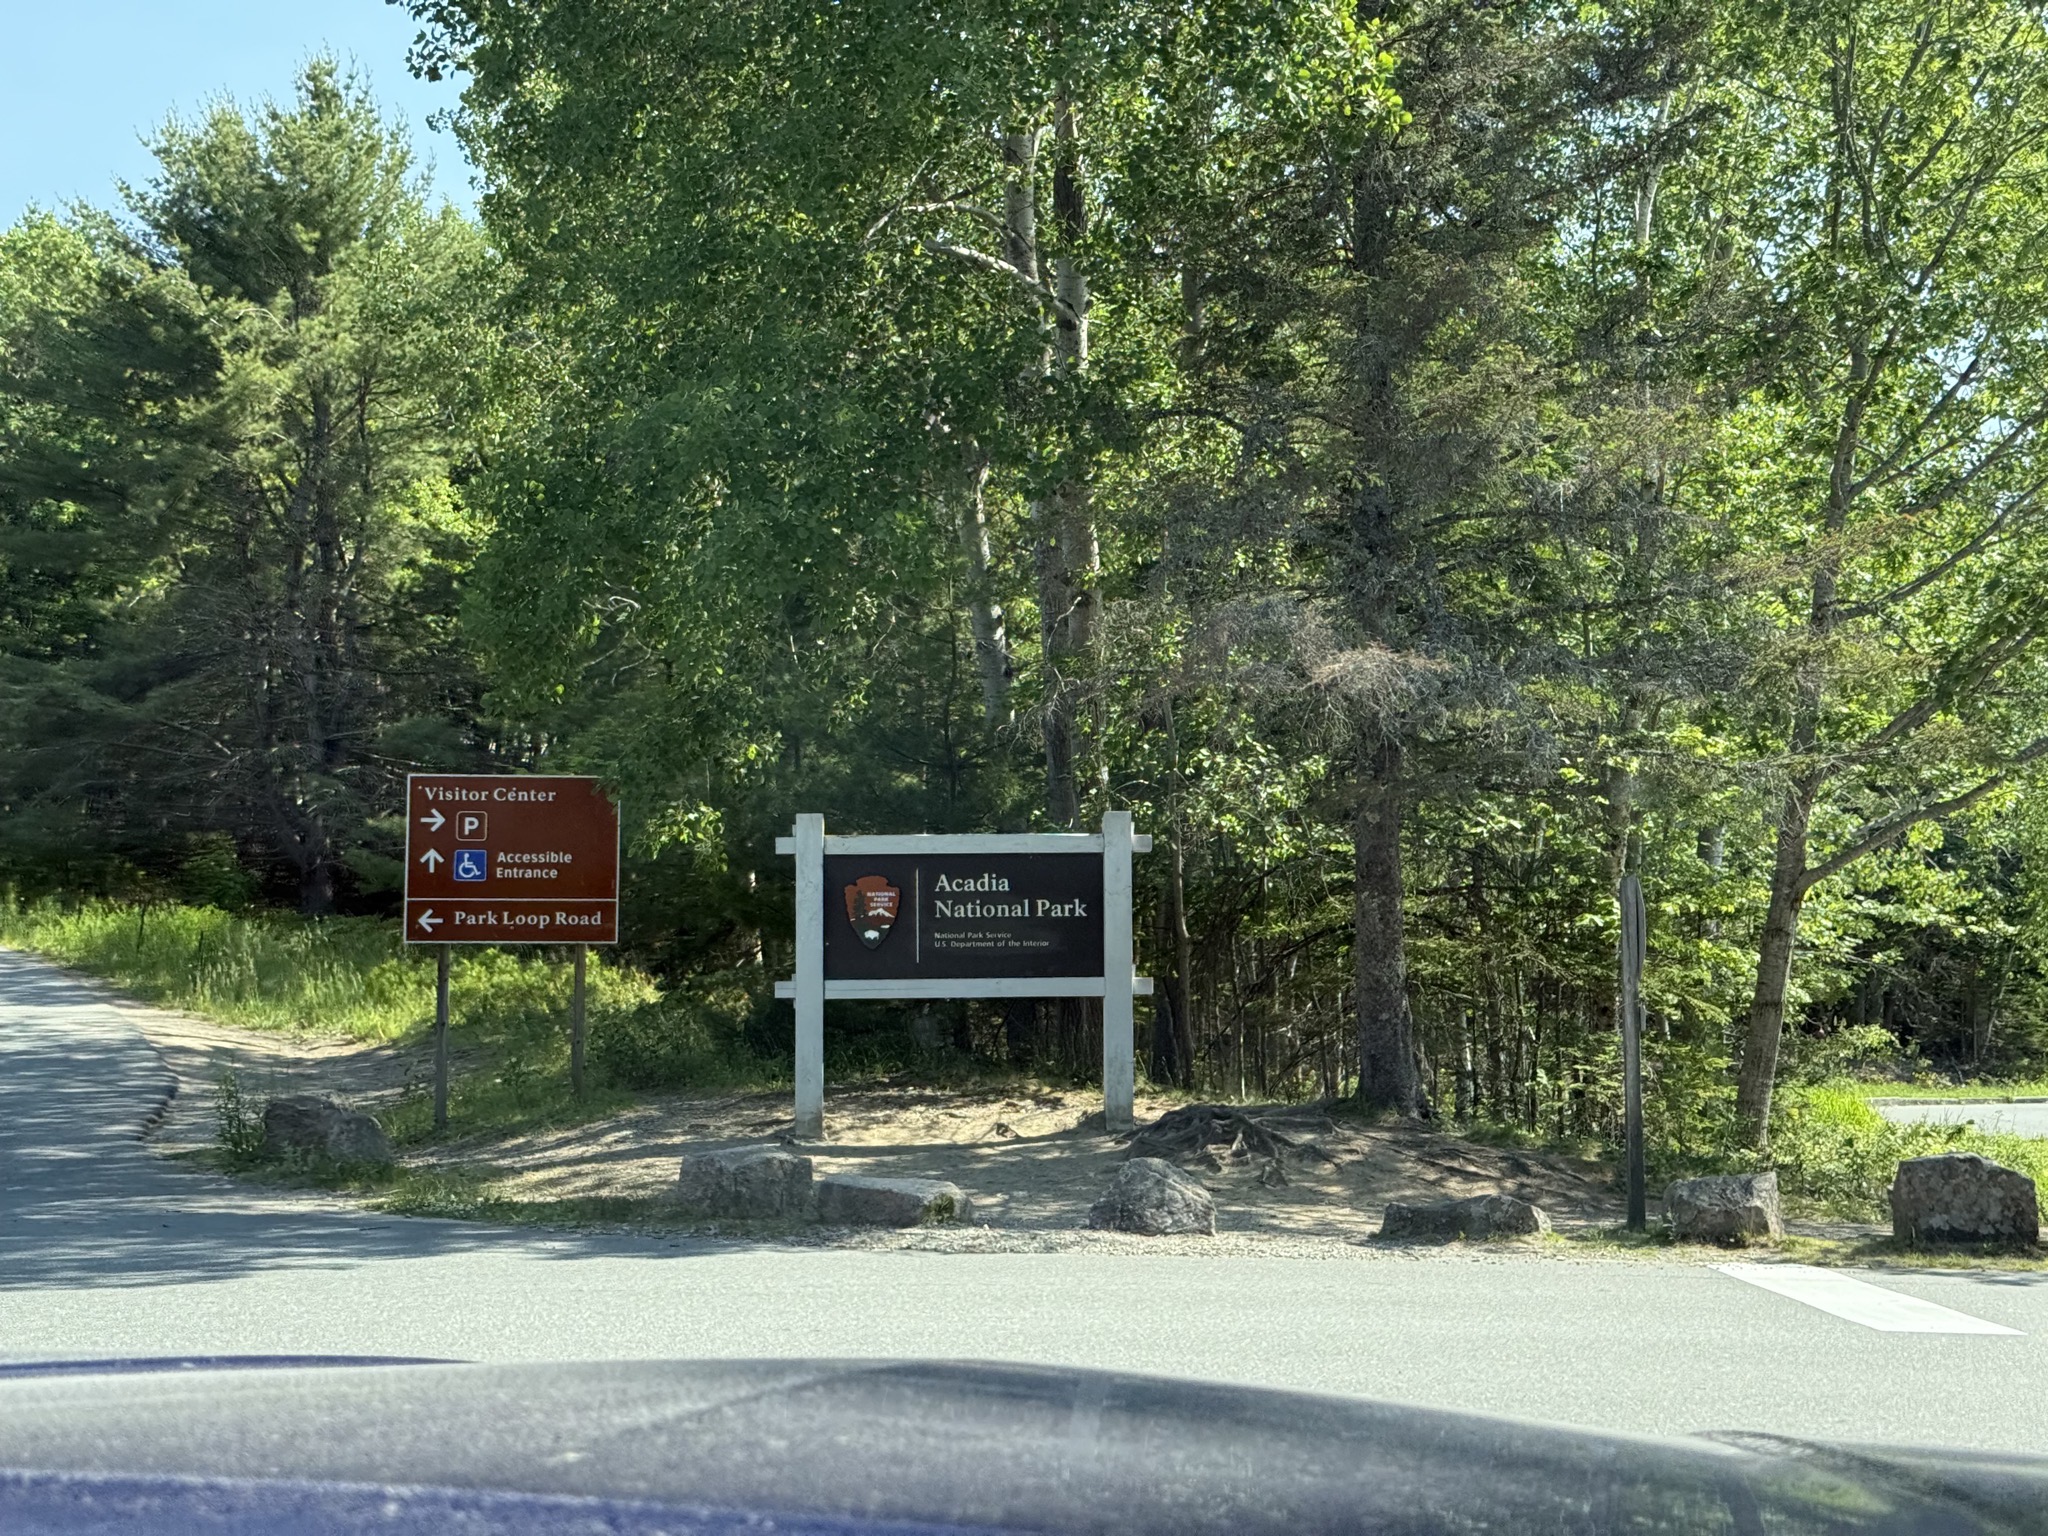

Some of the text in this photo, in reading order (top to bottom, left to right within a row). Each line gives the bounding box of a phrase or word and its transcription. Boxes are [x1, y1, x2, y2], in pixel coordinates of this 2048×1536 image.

[425, 787, 557, 801] Visitor Center
[464, 817, 479, 835] P
[497, 851, 573, 864] Accessible
[496, 867, 558, 879] Entrance
[934, 873, 1010, 892] Acadia
[934, 899, 1088, 918] National Park
[454, 911, 602, 929] Park Loop Road
[950, 940, 995, 949] Department
